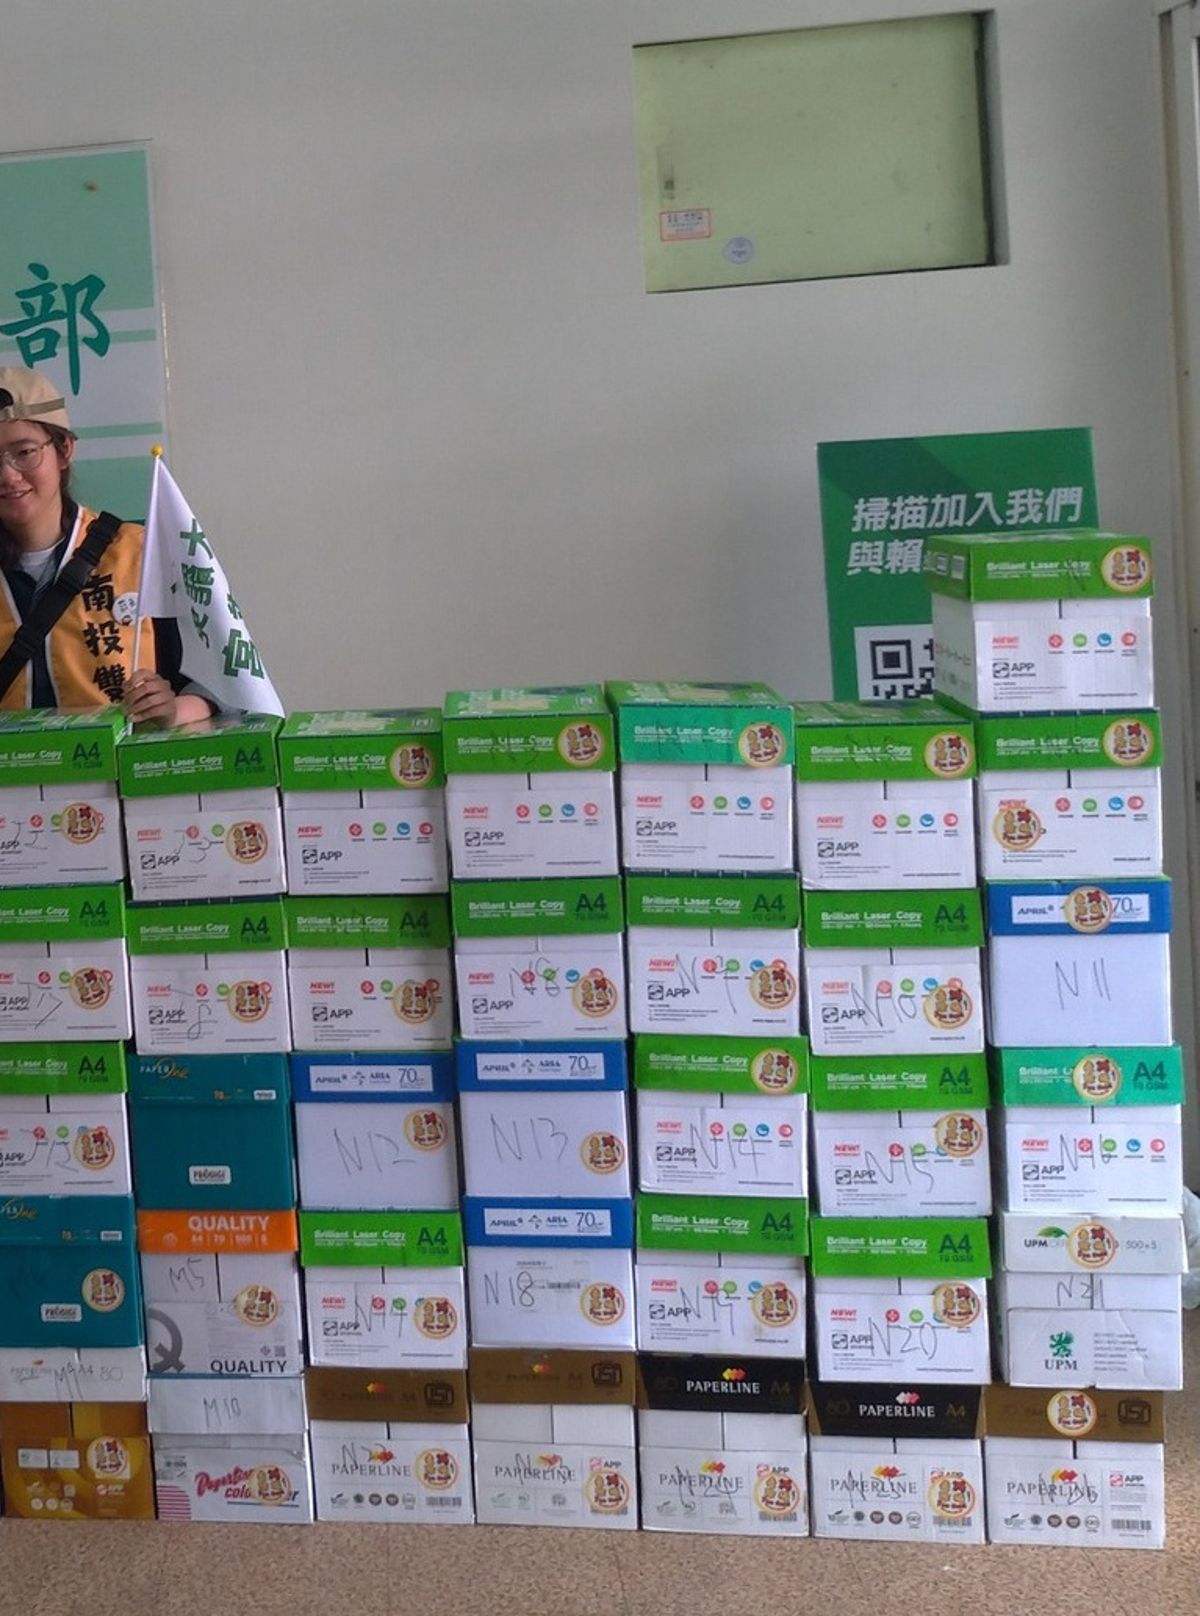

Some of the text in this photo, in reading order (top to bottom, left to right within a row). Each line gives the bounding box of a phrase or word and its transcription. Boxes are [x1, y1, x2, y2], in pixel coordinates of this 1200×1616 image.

[851, 486, 1083, 532] 掃描加入我們
[846, 538, 930, 576] 與賴
[73, 742, 100, 761] A4
[234, 747, 261, 767] A4
[654, 822, 676, 831] APP
[482, 832, 504, 842] APP
[836, 842, 859, 852] APP
[319, 851, 343, 862] APP
[576, 893, 607, 910] A4
[753, 894, 784, 912] A4
[1112, 897, 1132, 912] 70
[80, 901, 107, 919] A4
[934, 904, 965, 922] A4
[240, 917, 269, 935] A4
[401, 911, 430, 929] A4
[490, 1000, 514, 1010] APP
[330, 1009, 353, 1019] APP
[78, 1056, 106, 1075] A4
[569, 1056, 588, 1071] 70
[1133, 1062, 1166, 1080] A4
[399, 1068, 416, 1084] 70
[939, 1067, 971, 1086] A4
[188, 1216, 270, 1230] QUALITY
[576, 1212, 595, 1227] 70
[761, 1212, 793, 1231] A4
[417, 1228, 447, 1245] A4
[939, 1233, 972, 1252] A4
[1024, 1239, 1048, 1247] UPM
[484, 1271, 535, 1307] N18
[668, 1308, 691, 1317] APP
[210, 1360, 287, 1373] QUALITY
[1045, 1360, 1078, 1370] UPM
[687, 1380, 760, 1395] PAPERLINE
[859, 1404, 935, 1418] PAPERLINE
[332, 1464, 411, 1477] PAPERLINE
